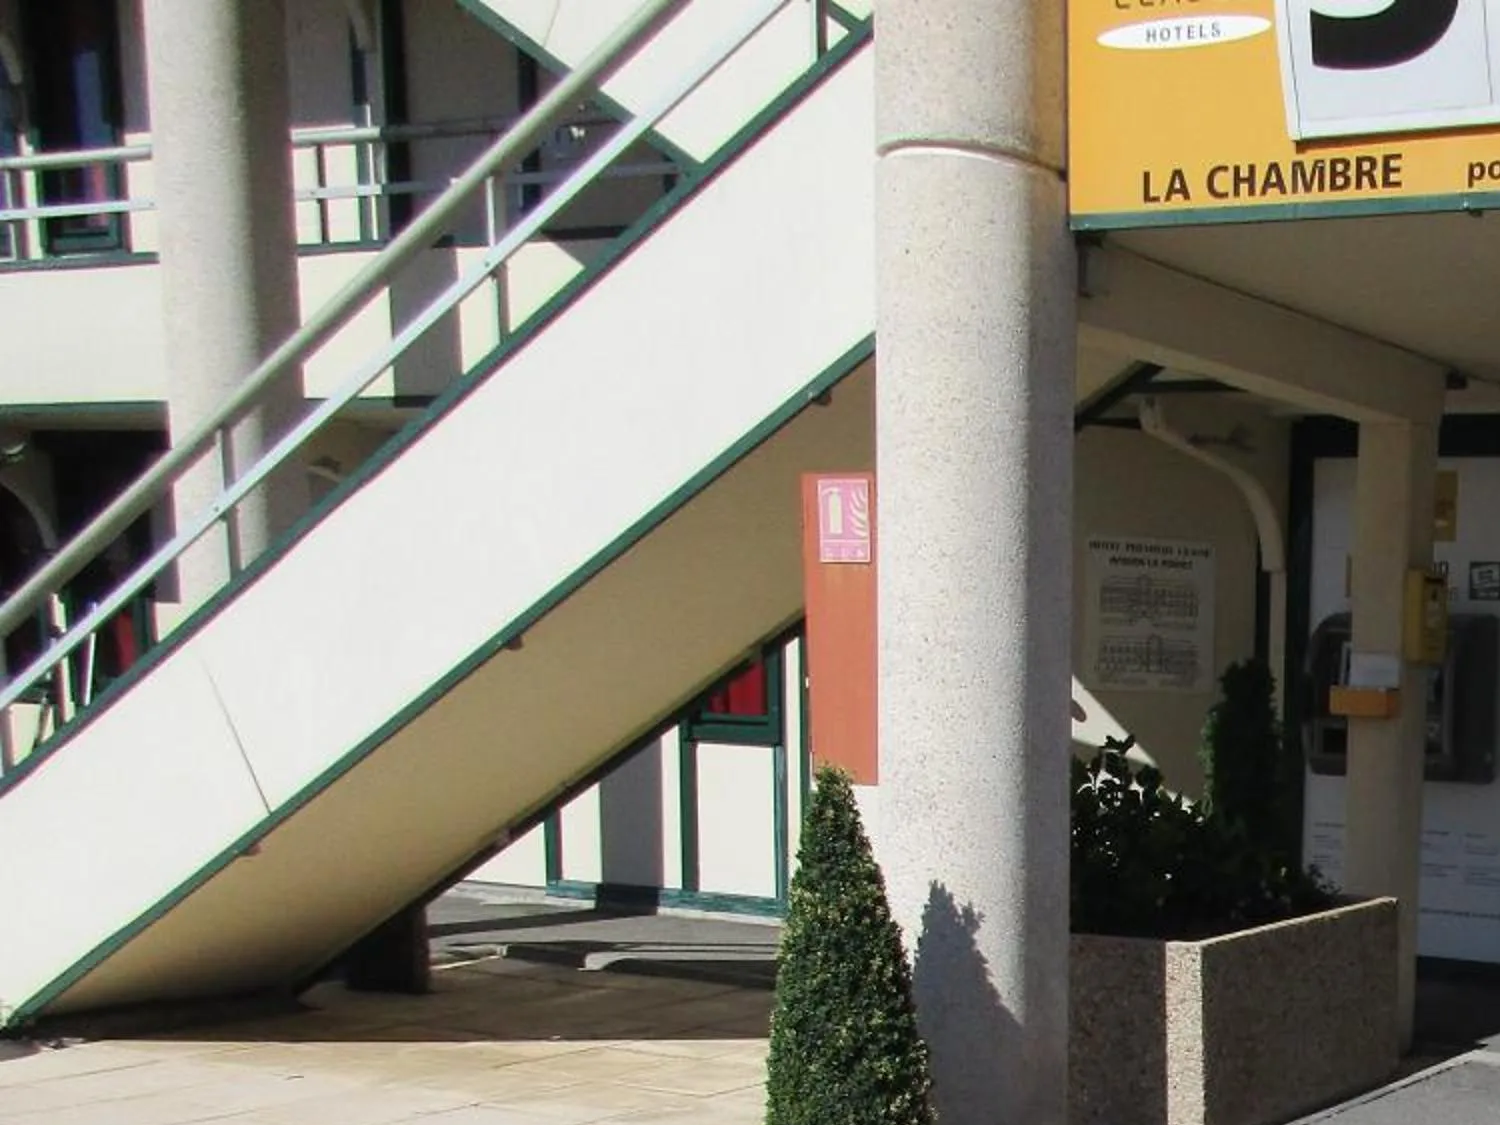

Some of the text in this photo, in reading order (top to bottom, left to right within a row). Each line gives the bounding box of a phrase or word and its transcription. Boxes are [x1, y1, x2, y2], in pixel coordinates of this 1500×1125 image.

[1145, 22, 1222, 44] HOTELS
[1142, 168, 1191, 204] LA
[1206, 153, 1404, 199] CHAMBRE
